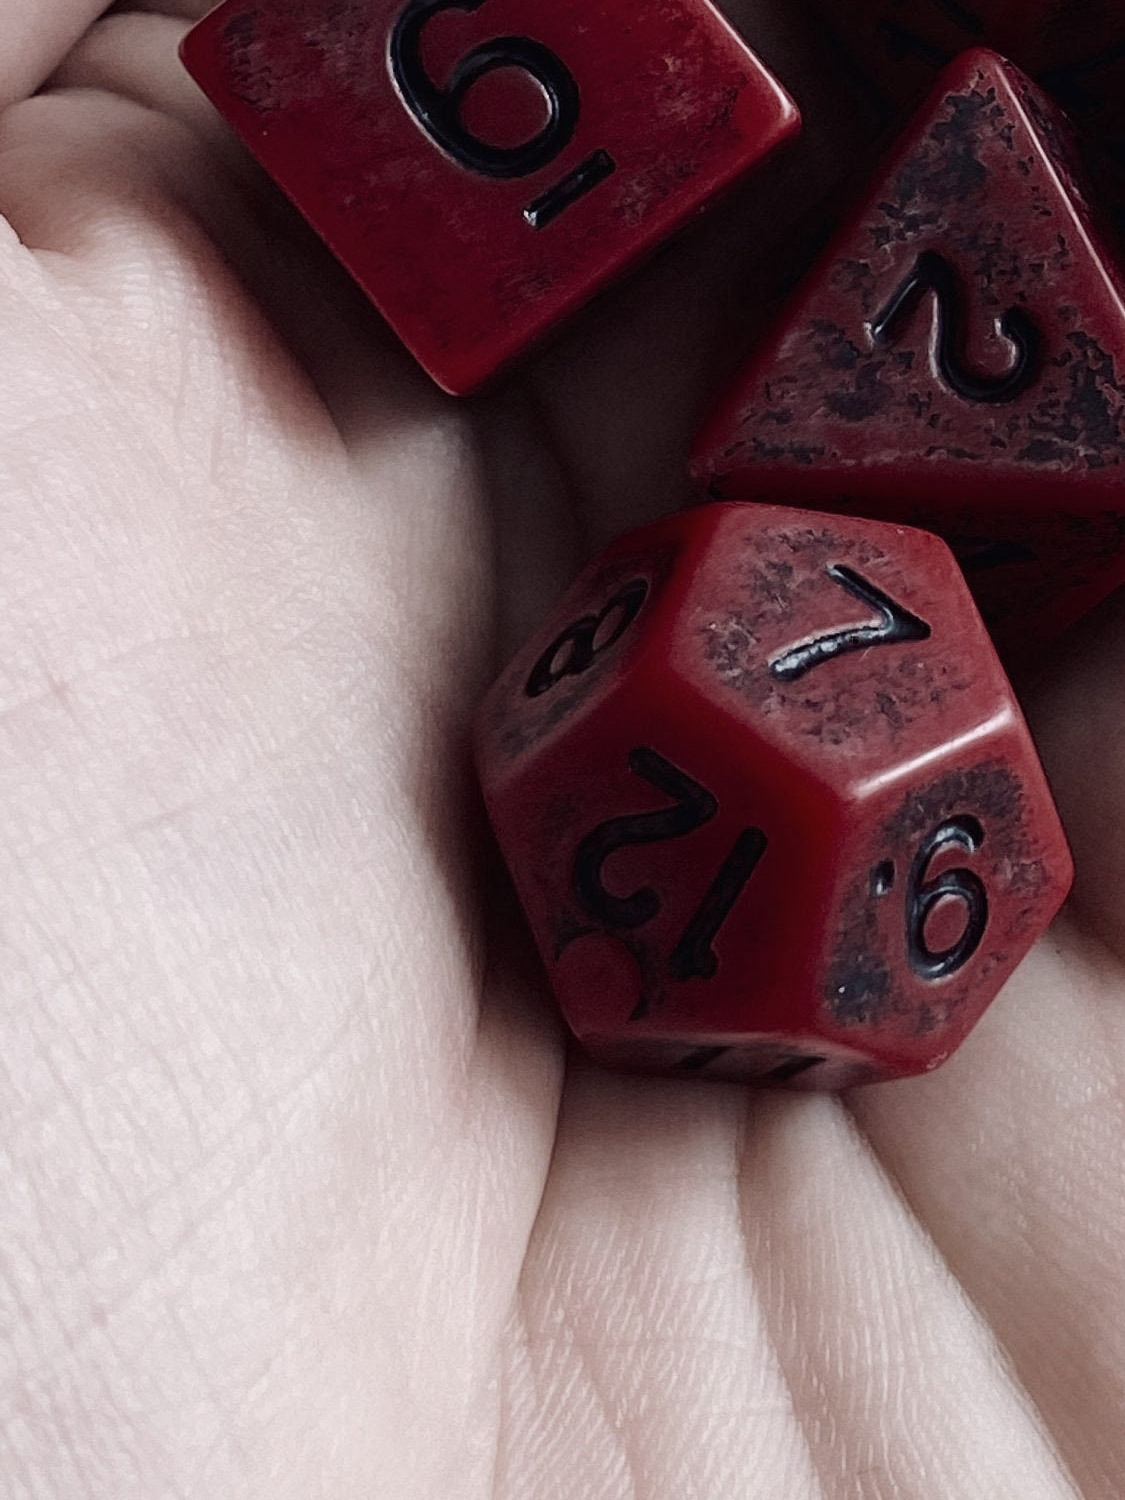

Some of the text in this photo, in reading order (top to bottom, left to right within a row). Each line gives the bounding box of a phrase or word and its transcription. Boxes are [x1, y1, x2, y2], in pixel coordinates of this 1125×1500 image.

[866, 249, 1042, 404] 2
[525, 577, 652, 698] 8
[770, 563, 932, 683] 7
[572, 745, 769, 982] 12
